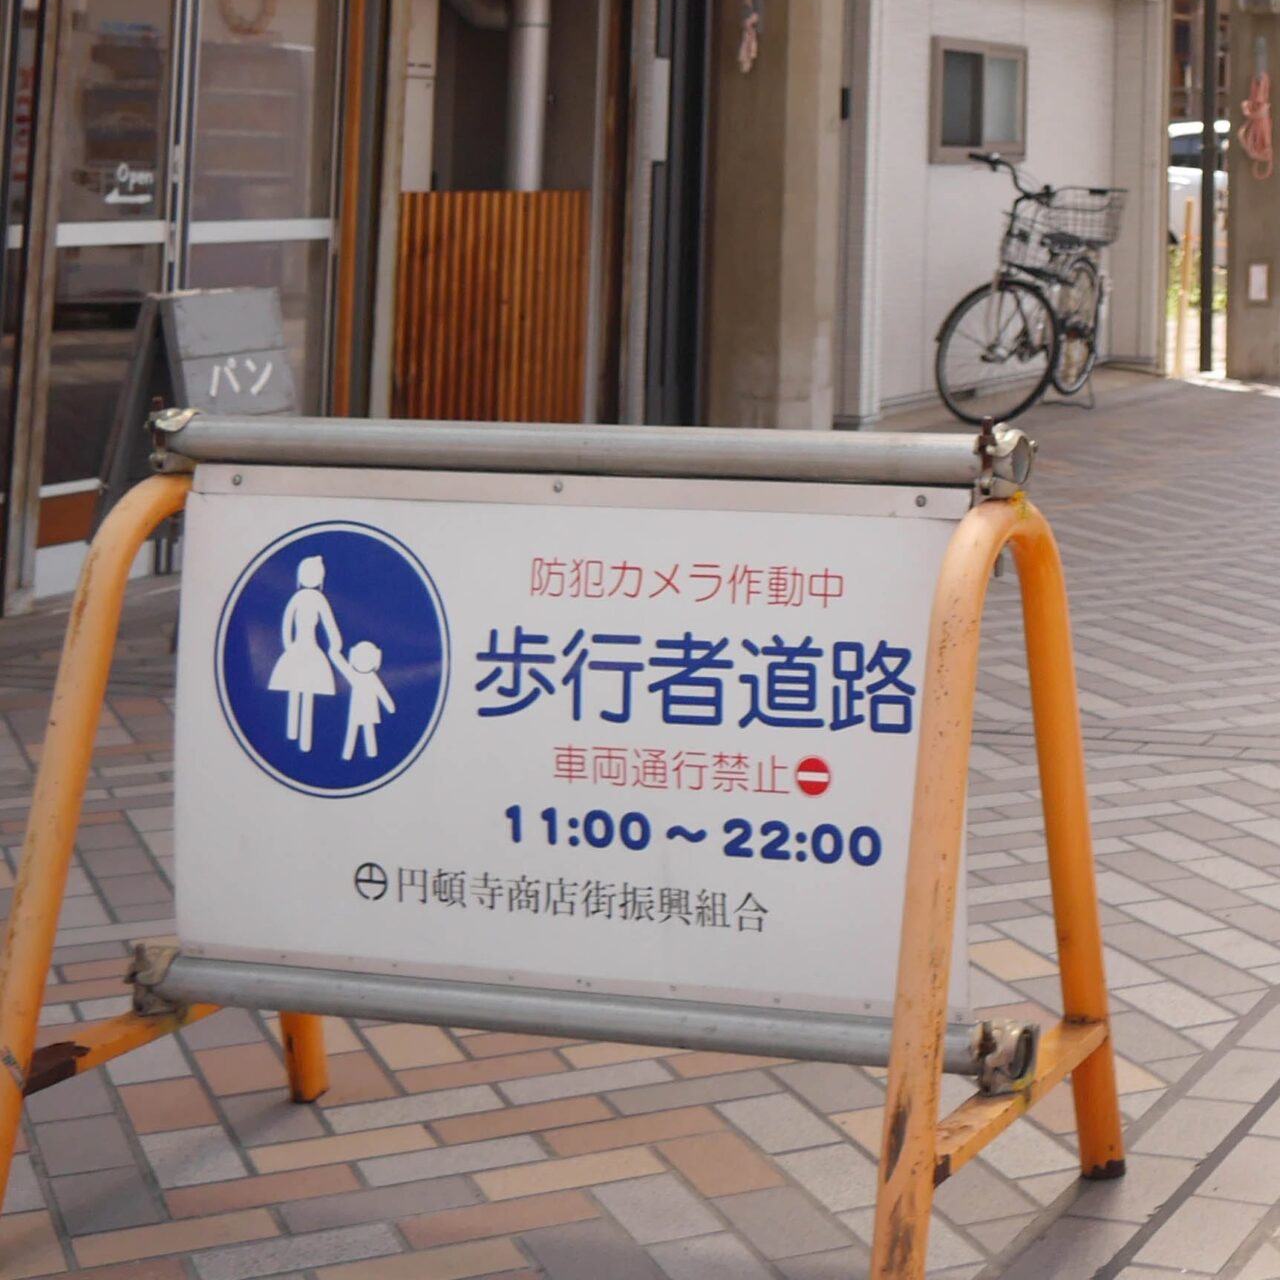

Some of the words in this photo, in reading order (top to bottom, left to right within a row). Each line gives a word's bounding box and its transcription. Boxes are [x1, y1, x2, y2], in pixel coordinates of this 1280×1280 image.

[209, 356, 273, 398] パン
[529, 556, 845, 609] 防犯カメラ作動中
[475, 625, 917, 735] 歩行者道路
[552, 744, 792, 795] 車両通行禁止
[396, 865, 770, 933] 円頓寺商店街振興組合
